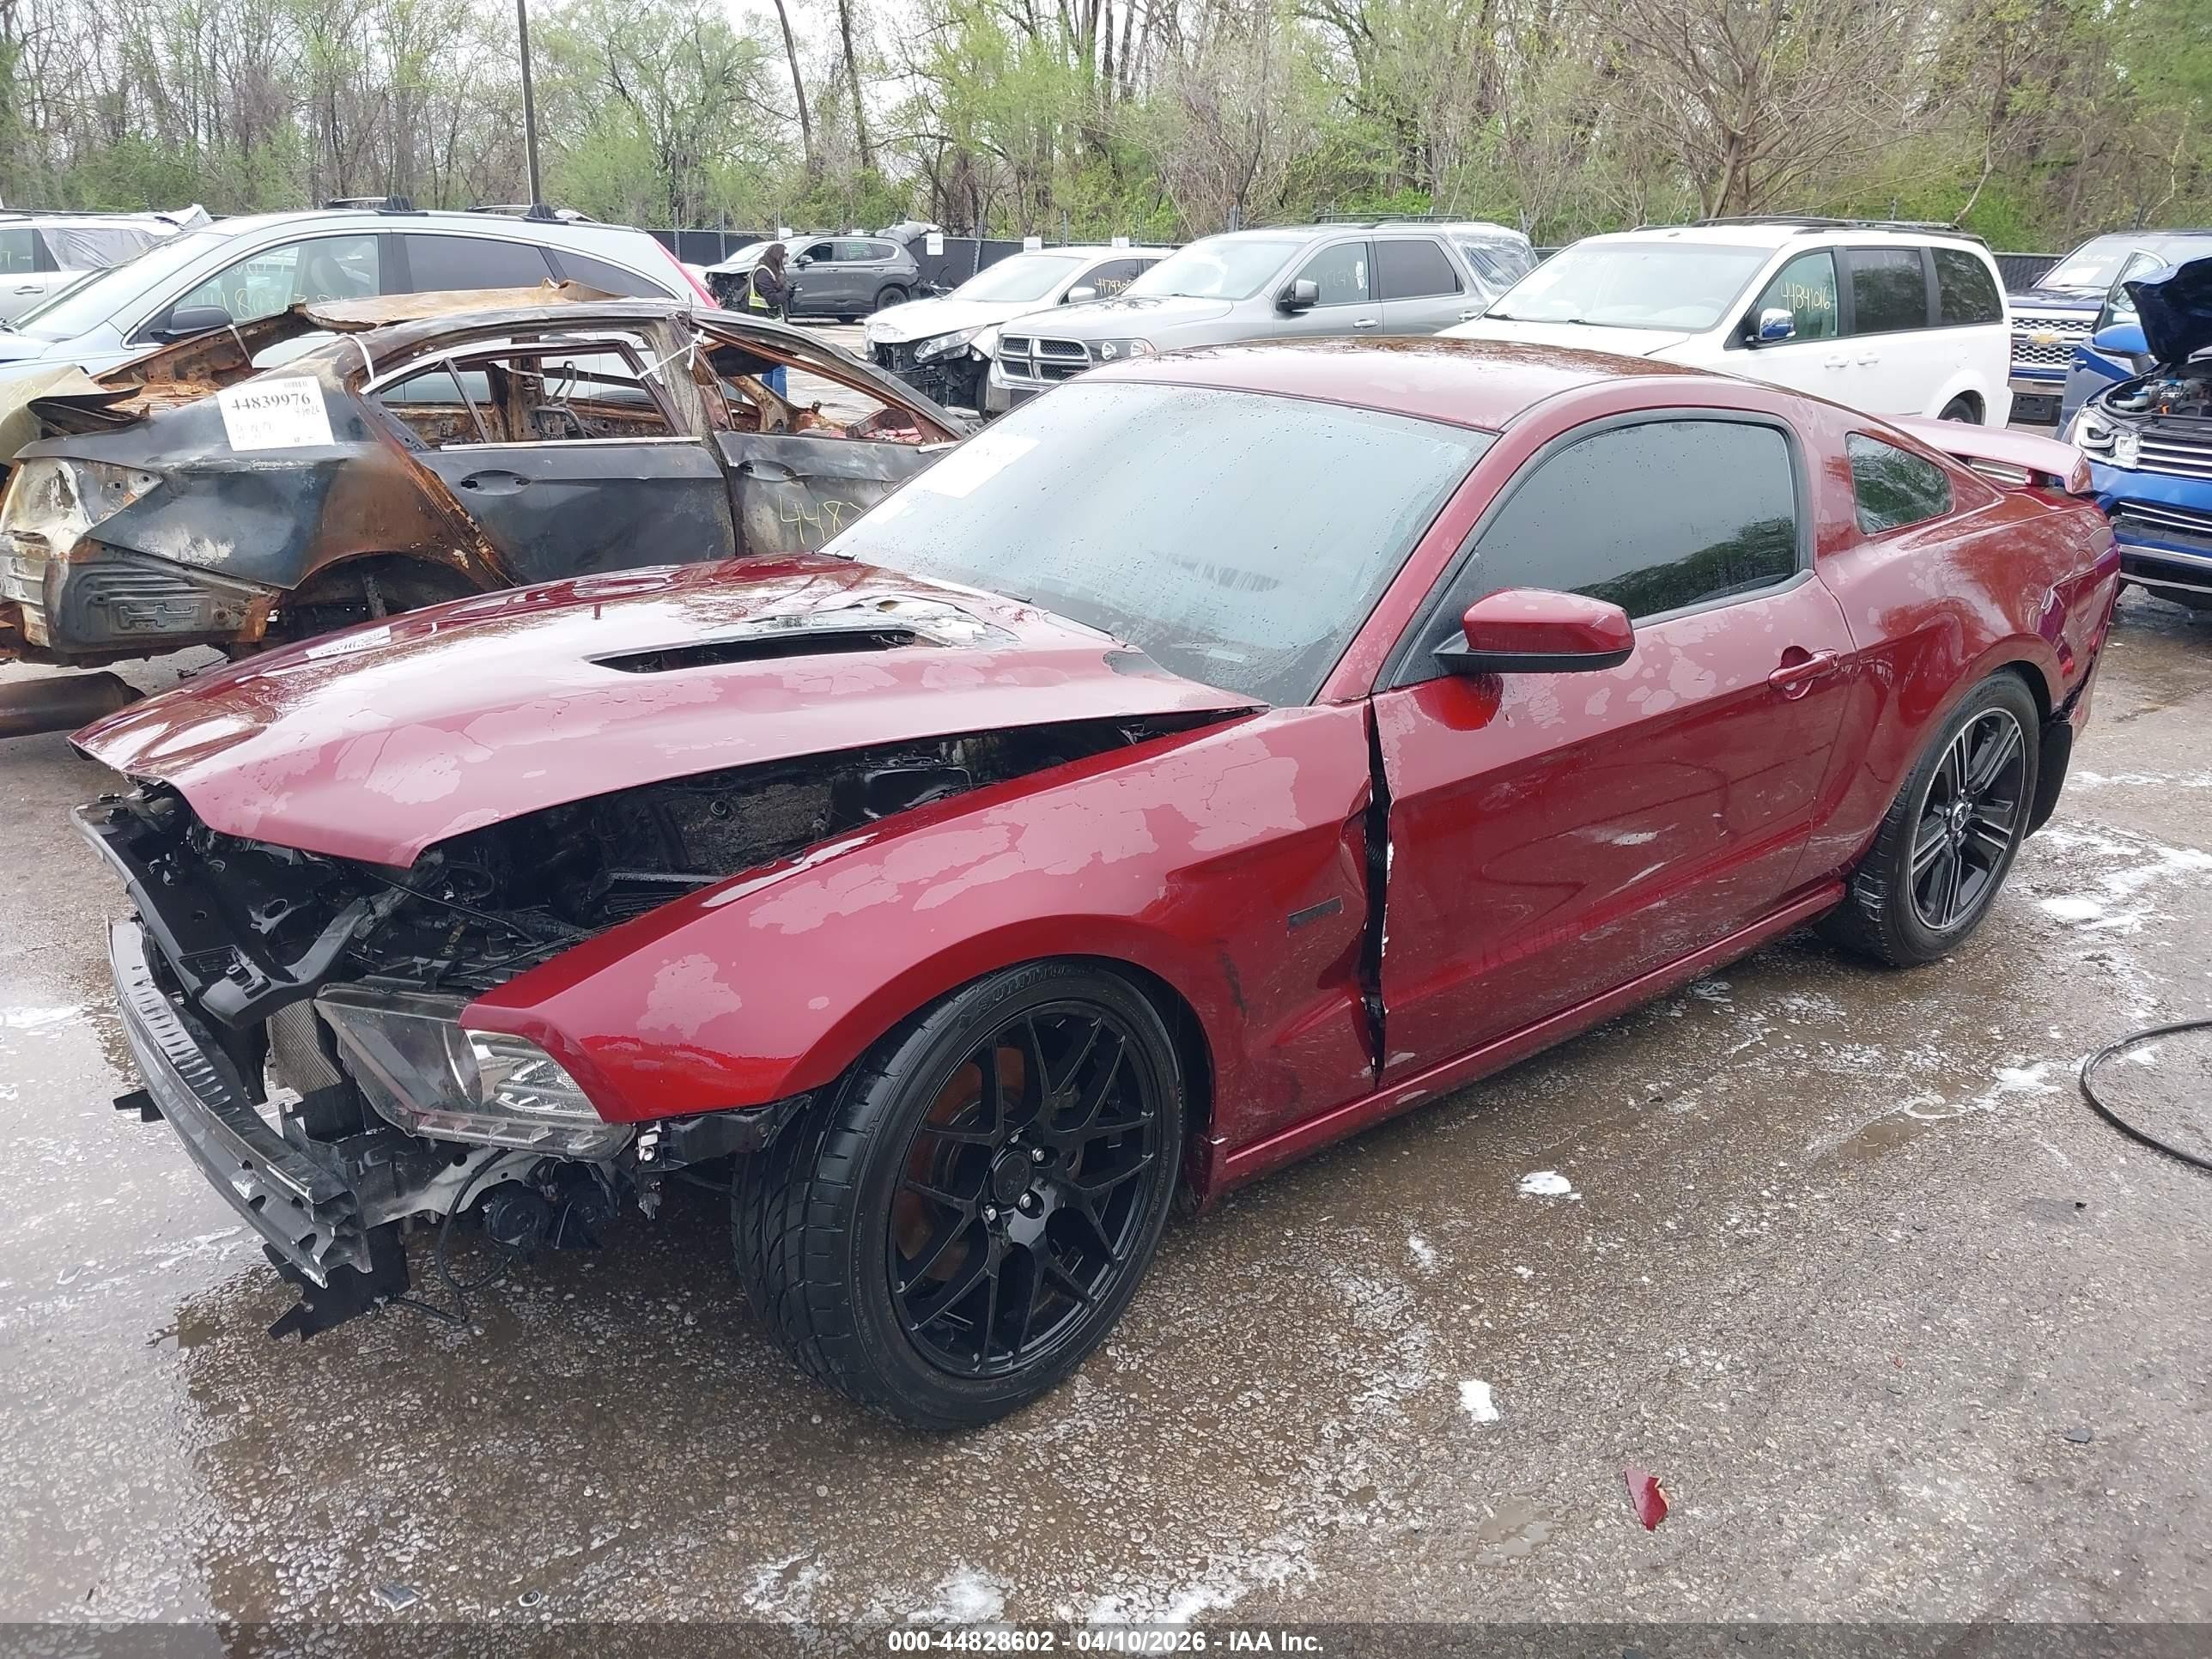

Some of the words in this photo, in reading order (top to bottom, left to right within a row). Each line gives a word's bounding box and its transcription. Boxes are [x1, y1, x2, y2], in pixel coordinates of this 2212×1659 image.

[1781, 282, 1831, 313] 44841016
[231, 392, 311, 410] 44839976
[778, 495, 864, 544] 448
